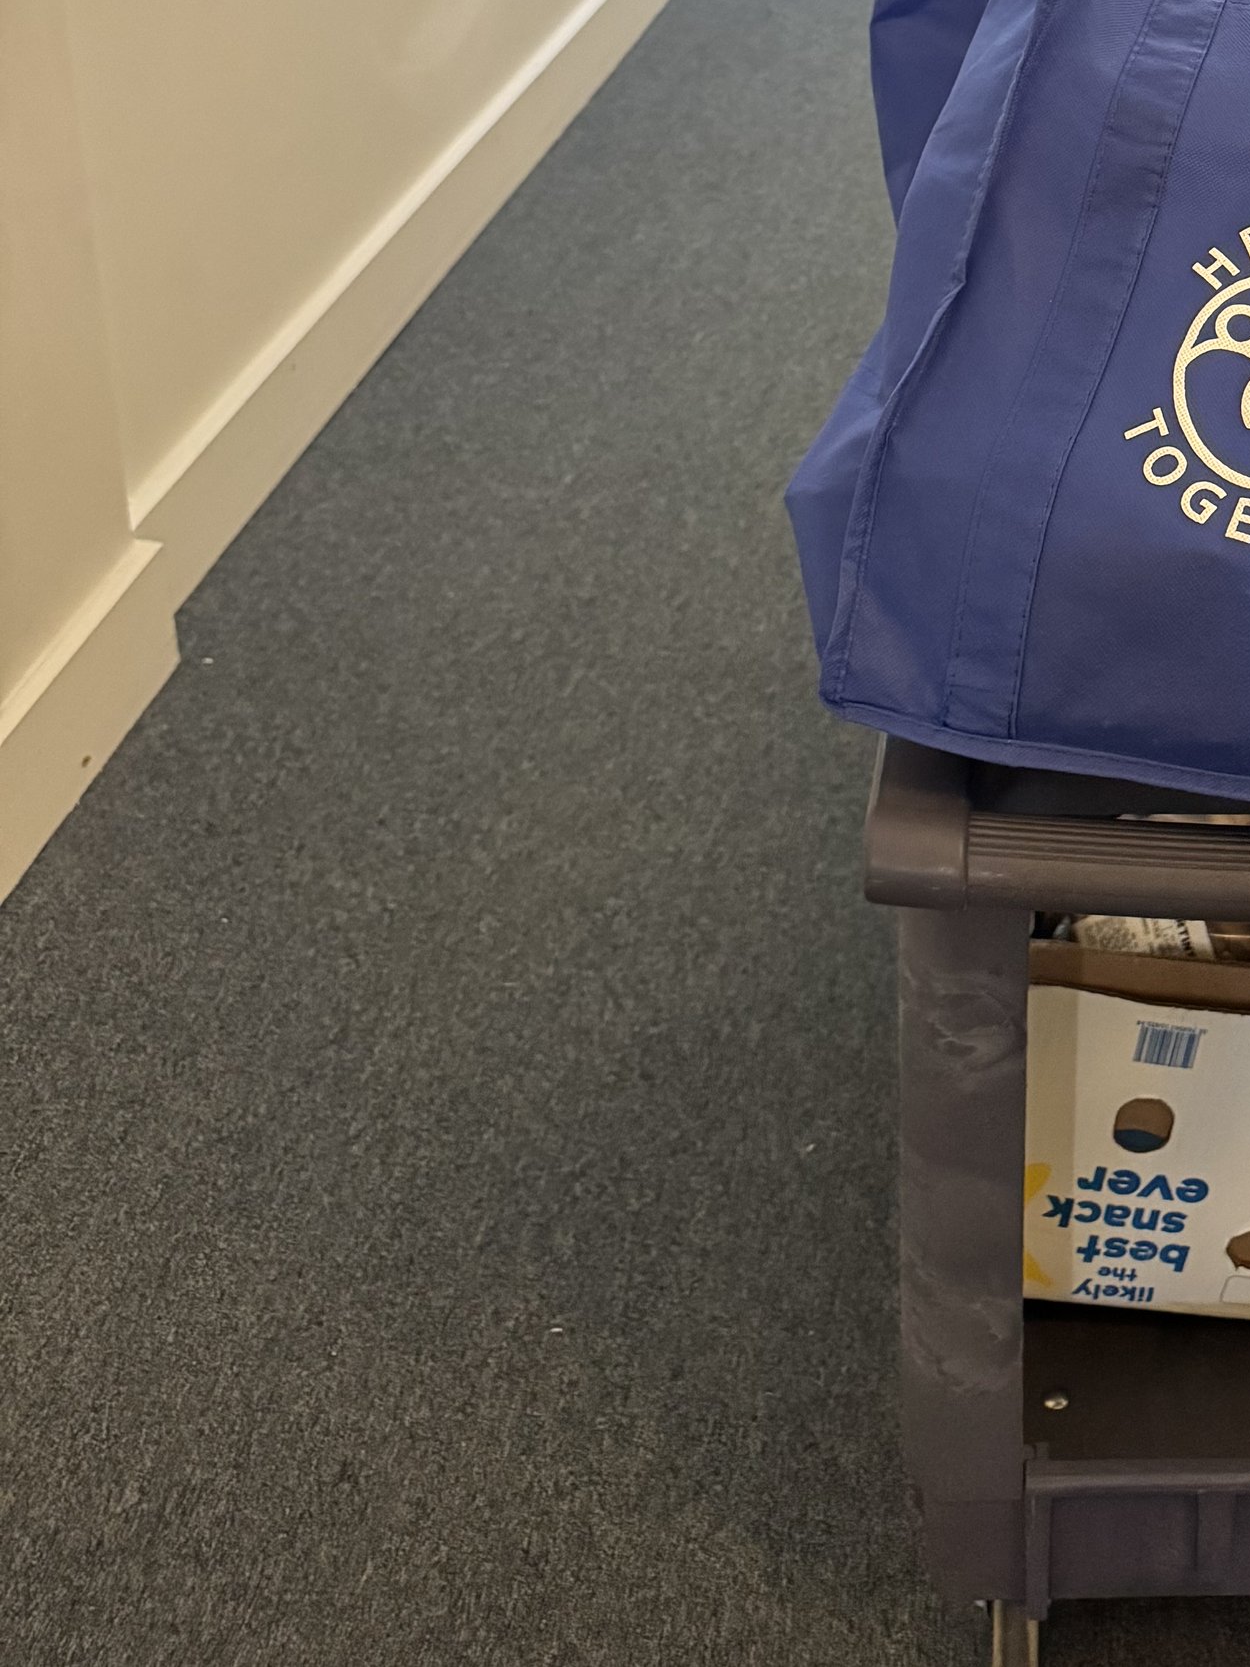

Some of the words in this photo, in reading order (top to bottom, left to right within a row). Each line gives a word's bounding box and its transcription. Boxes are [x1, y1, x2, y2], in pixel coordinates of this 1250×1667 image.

[1077, 1166, 1209, 1203] ever
[1042, 1194, 1188, 1234] snack
[1076, 1235, 1190, 1273] best
[1072, 1278, 1155, 1302] likely
[1098, 1266, 1138, 1282] the
